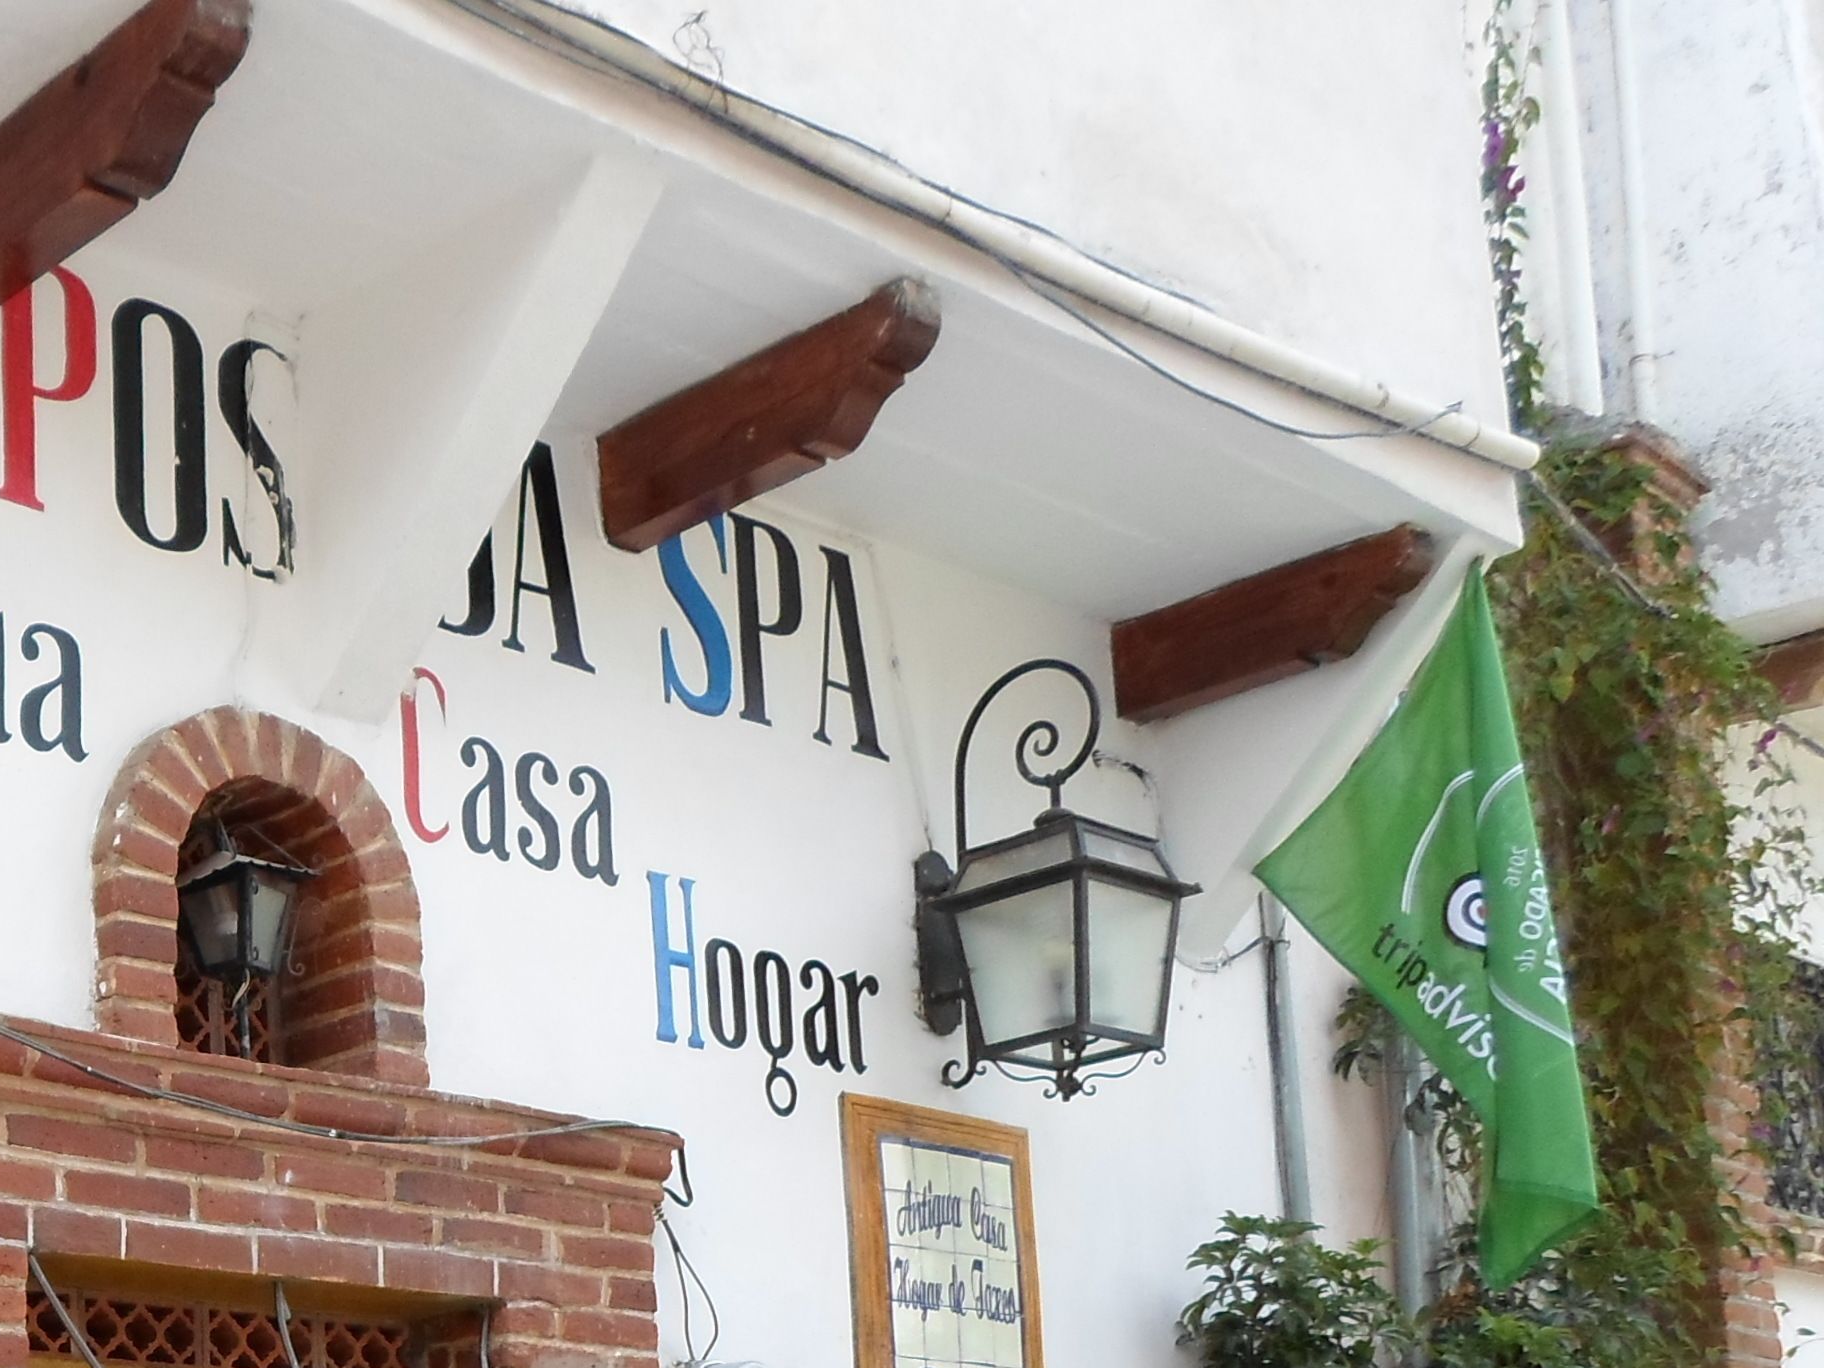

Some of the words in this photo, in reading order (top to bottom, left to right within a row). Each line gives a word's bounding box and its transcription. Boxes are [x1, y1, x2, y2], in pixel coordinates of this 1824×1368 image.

[660, 510, 891, 762] SPA
[400, 667, 620, 887] Casa
[646, 870, 880, 1118] Hogar
[893, 1257, 943, 1323] Hogar
[948, 1263, 967, 1317] de
[970, 1258, 1018, 1325] Taxco
[896, 1179, 962, 1240] Antigua
[970, 1186, 1008, 1252] Casa
